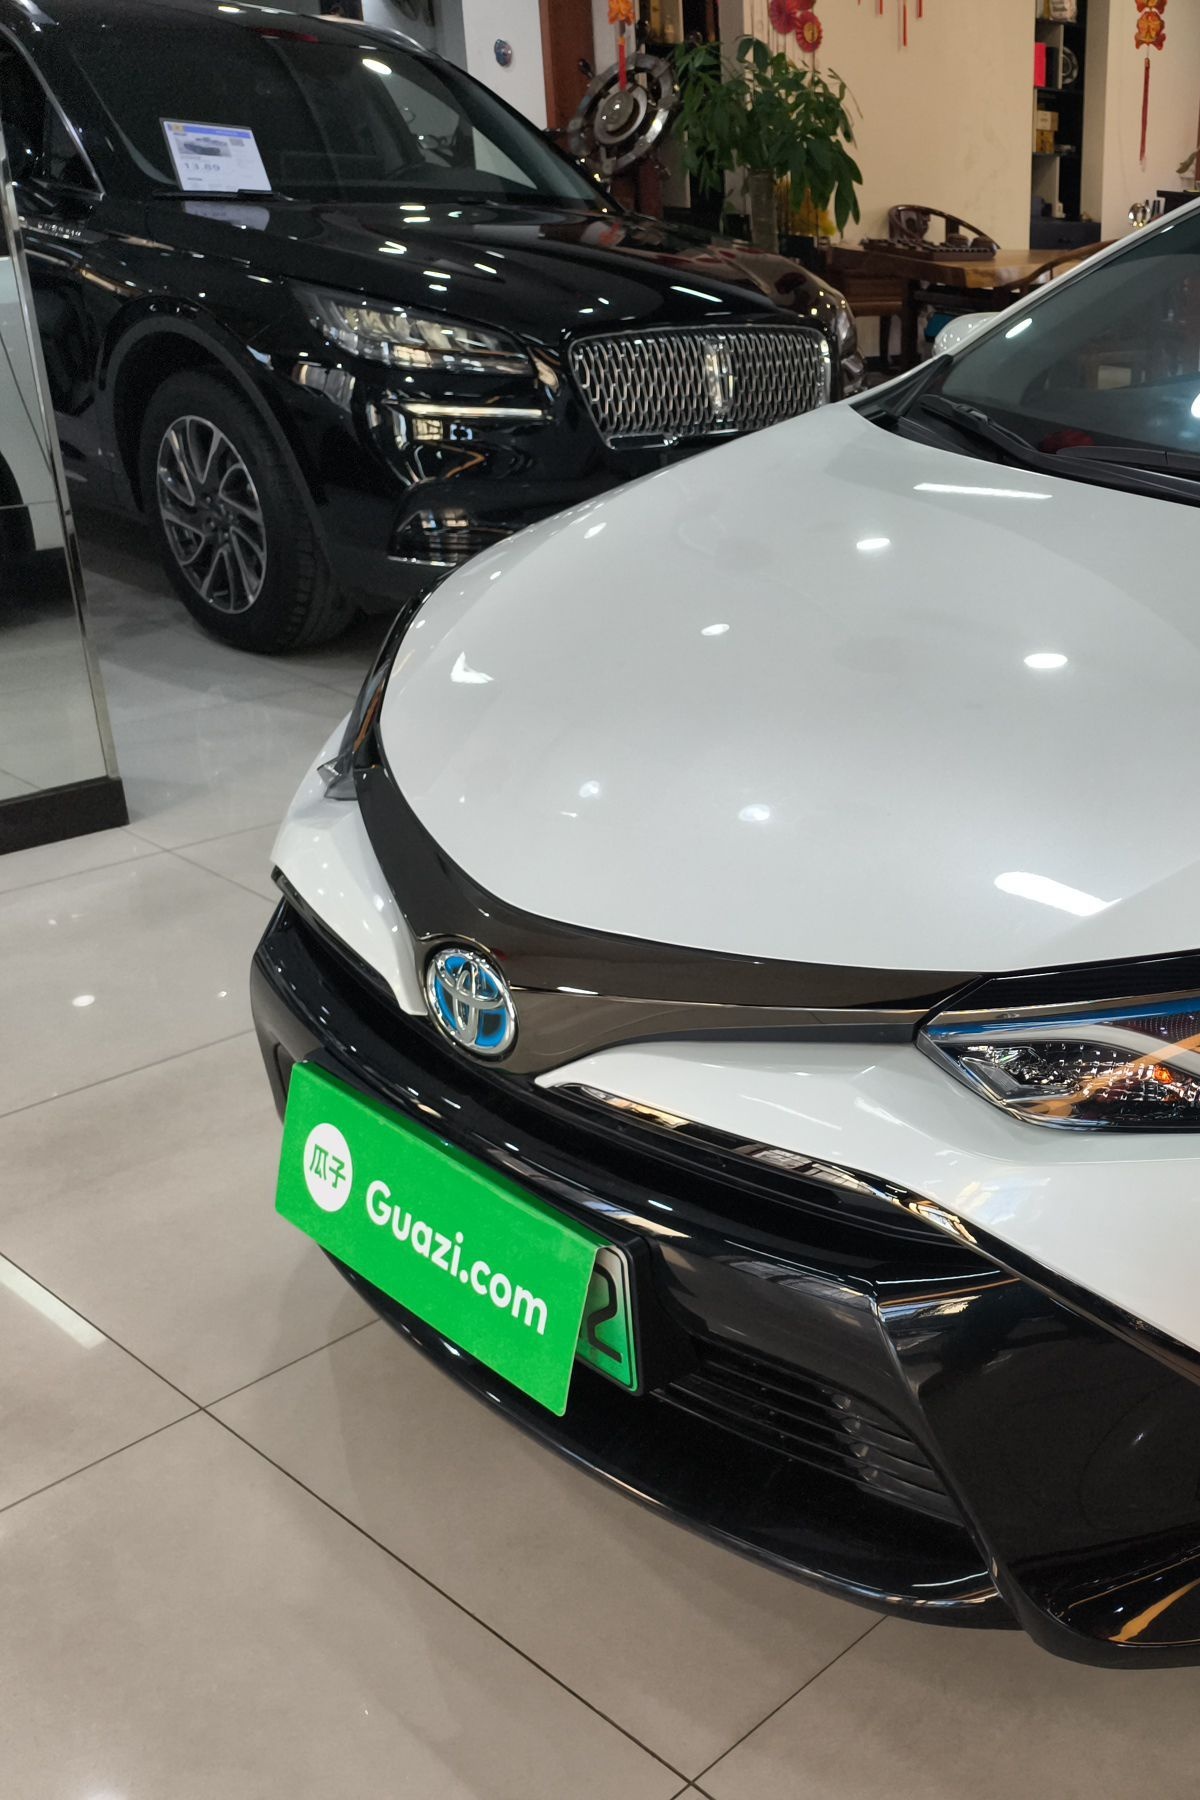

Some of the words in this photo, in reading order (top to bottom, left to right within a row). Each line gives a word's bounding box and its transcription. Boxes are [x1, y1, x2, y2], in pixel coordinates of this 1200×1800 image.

[310, 1144, 346, 1190] 瓜子
[366, 1180, 548, 1335] Guazi.com
[587, 1263, 622, 1364] 2
